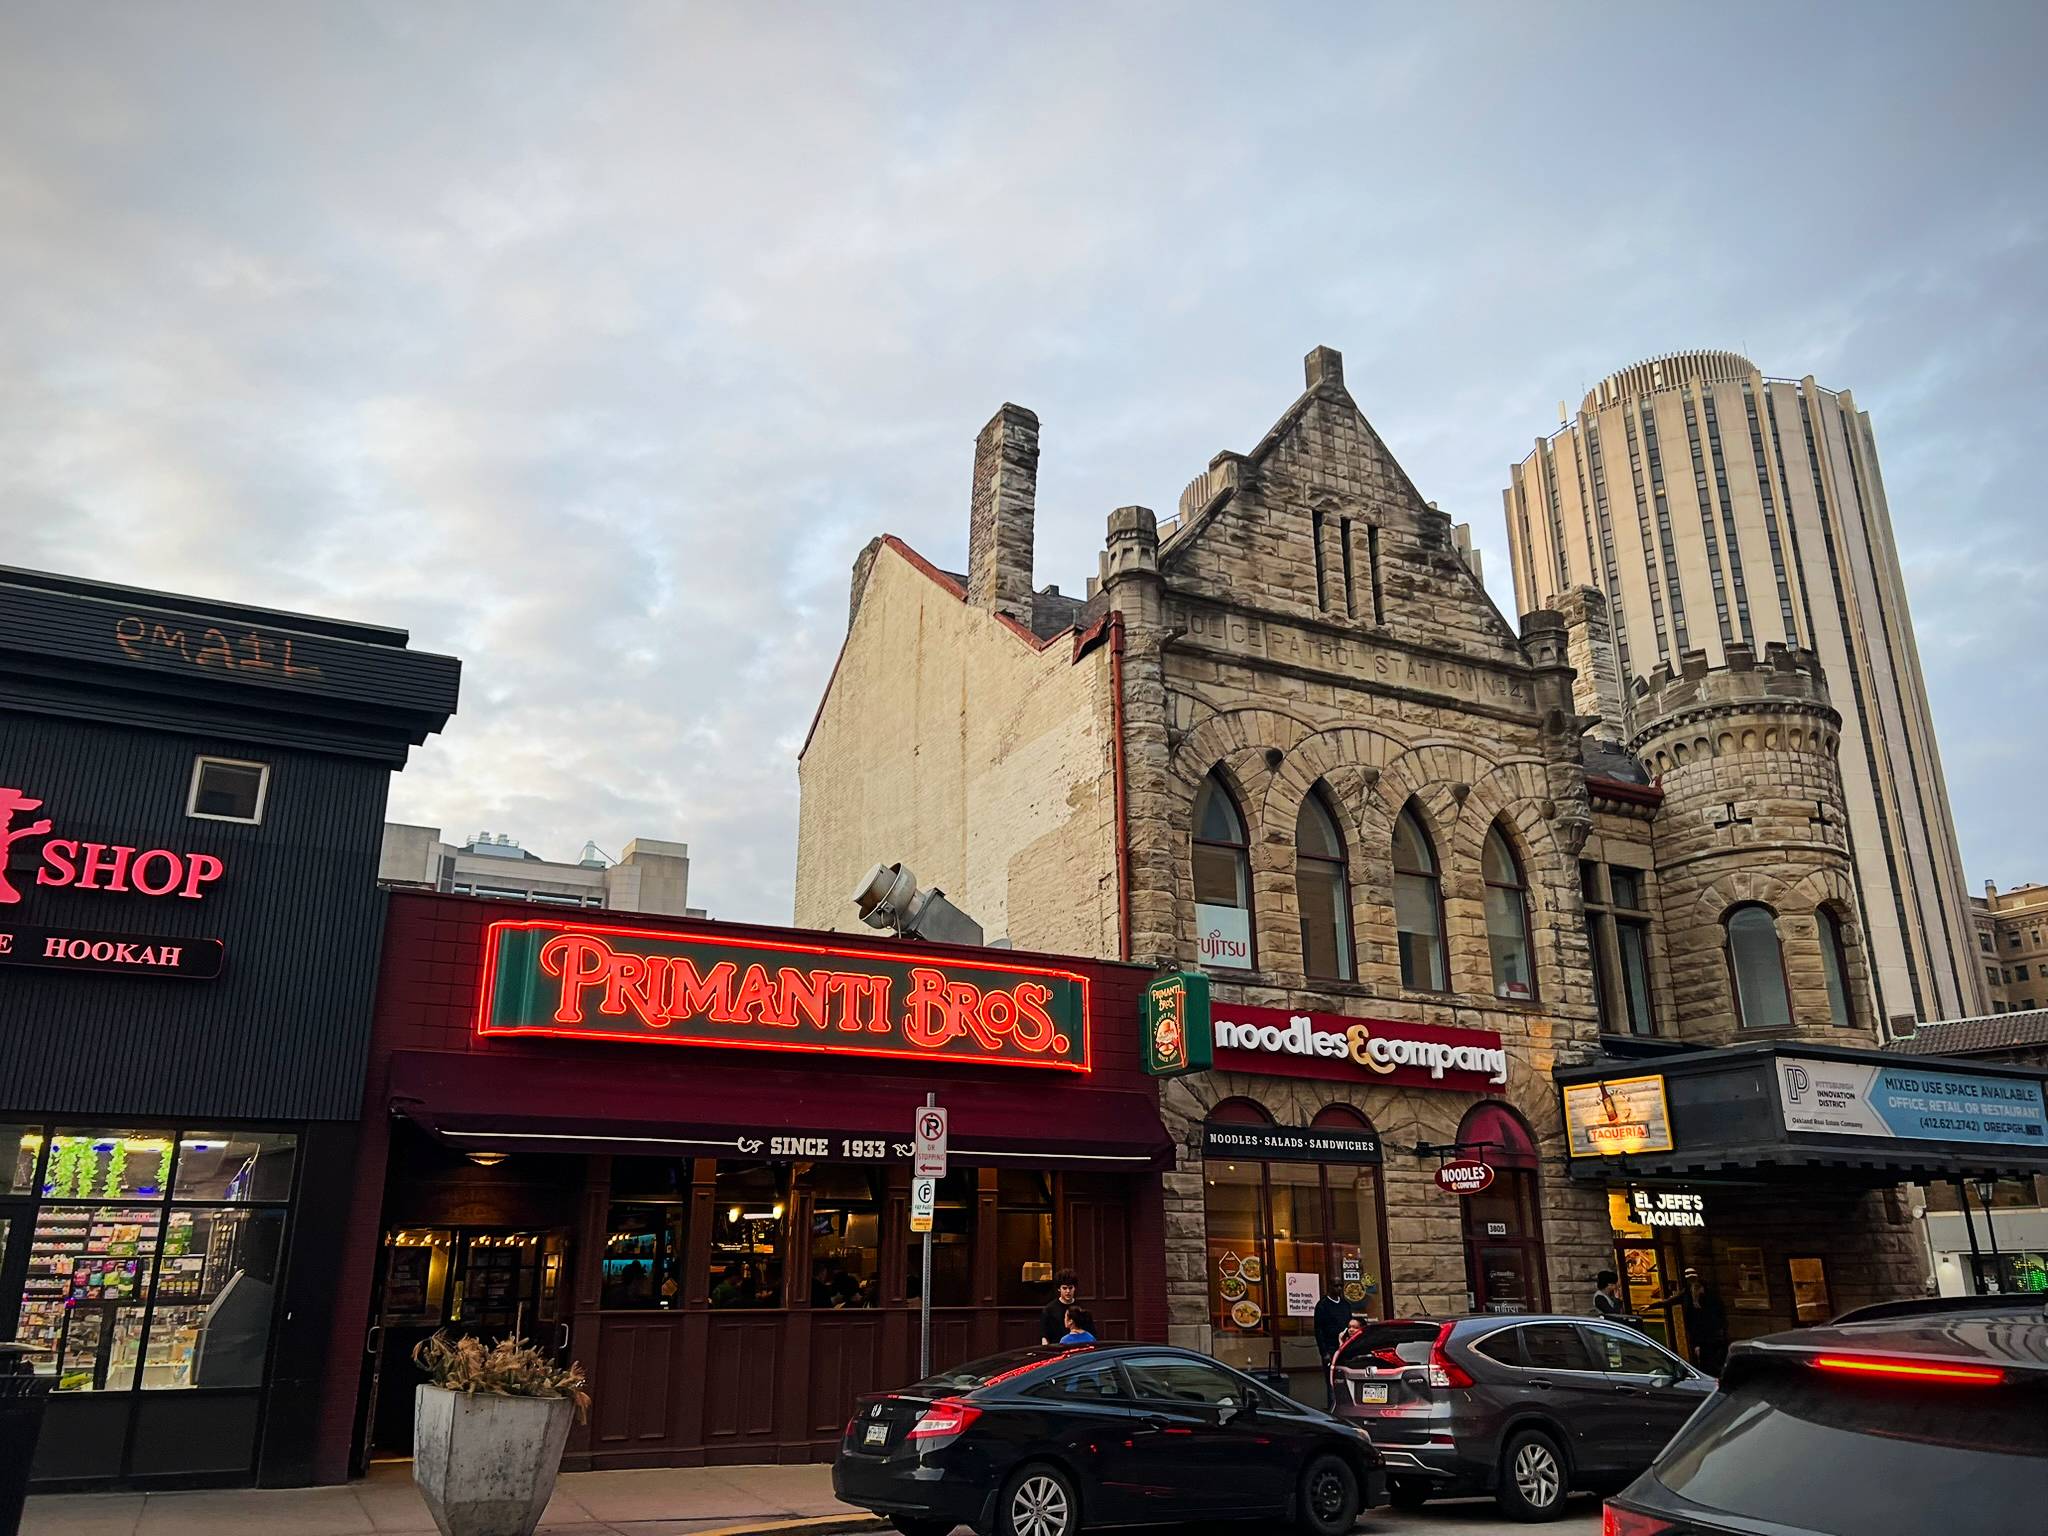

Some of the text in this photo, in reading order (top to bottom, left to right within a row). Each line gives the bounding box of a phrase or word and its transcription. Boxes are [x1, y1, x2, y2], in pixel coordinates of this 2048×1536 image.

[1172, 610, 1262, 648] POLICE
[1271, 631, 1364, 671] PATROL
[1374, 655, 1473, 692] STATION
[36, 838, 224, 899] SHOP
[43, 937, 182, 967] HOOKAH
[540, 934, 893, 1031] PRIMANTI
[1817, 1090, 1856, 1100] INNOVATION
[1885, 1077, 1919, 1092] MIXED
[1922, 1082, 1943, 1094] USE
[1945, 1083, 1978, 1097] SPACE
[1818, 1100, 1847, 1109] DISTRICT
[1929, 1101, 1963, 1113] RETAIL
[1965, 1103, 1980, 1115] OR
[1981, 1104, 2040, 1119] RESTAURANT
[1209, 1133, 1374, 1151] NOODLES SALADS SANDWICHES
[1591, 1127, 1645, 1140] TAQUERIA
[770, 1136, 886, 1158] SINCE 1933
[1441, 1166, 1486, 1183] NOODLES
[1634, 1193, 1703, 1210] EL JEFE'S
[1638, 1211, 1704, 1226] TAQUERIA
